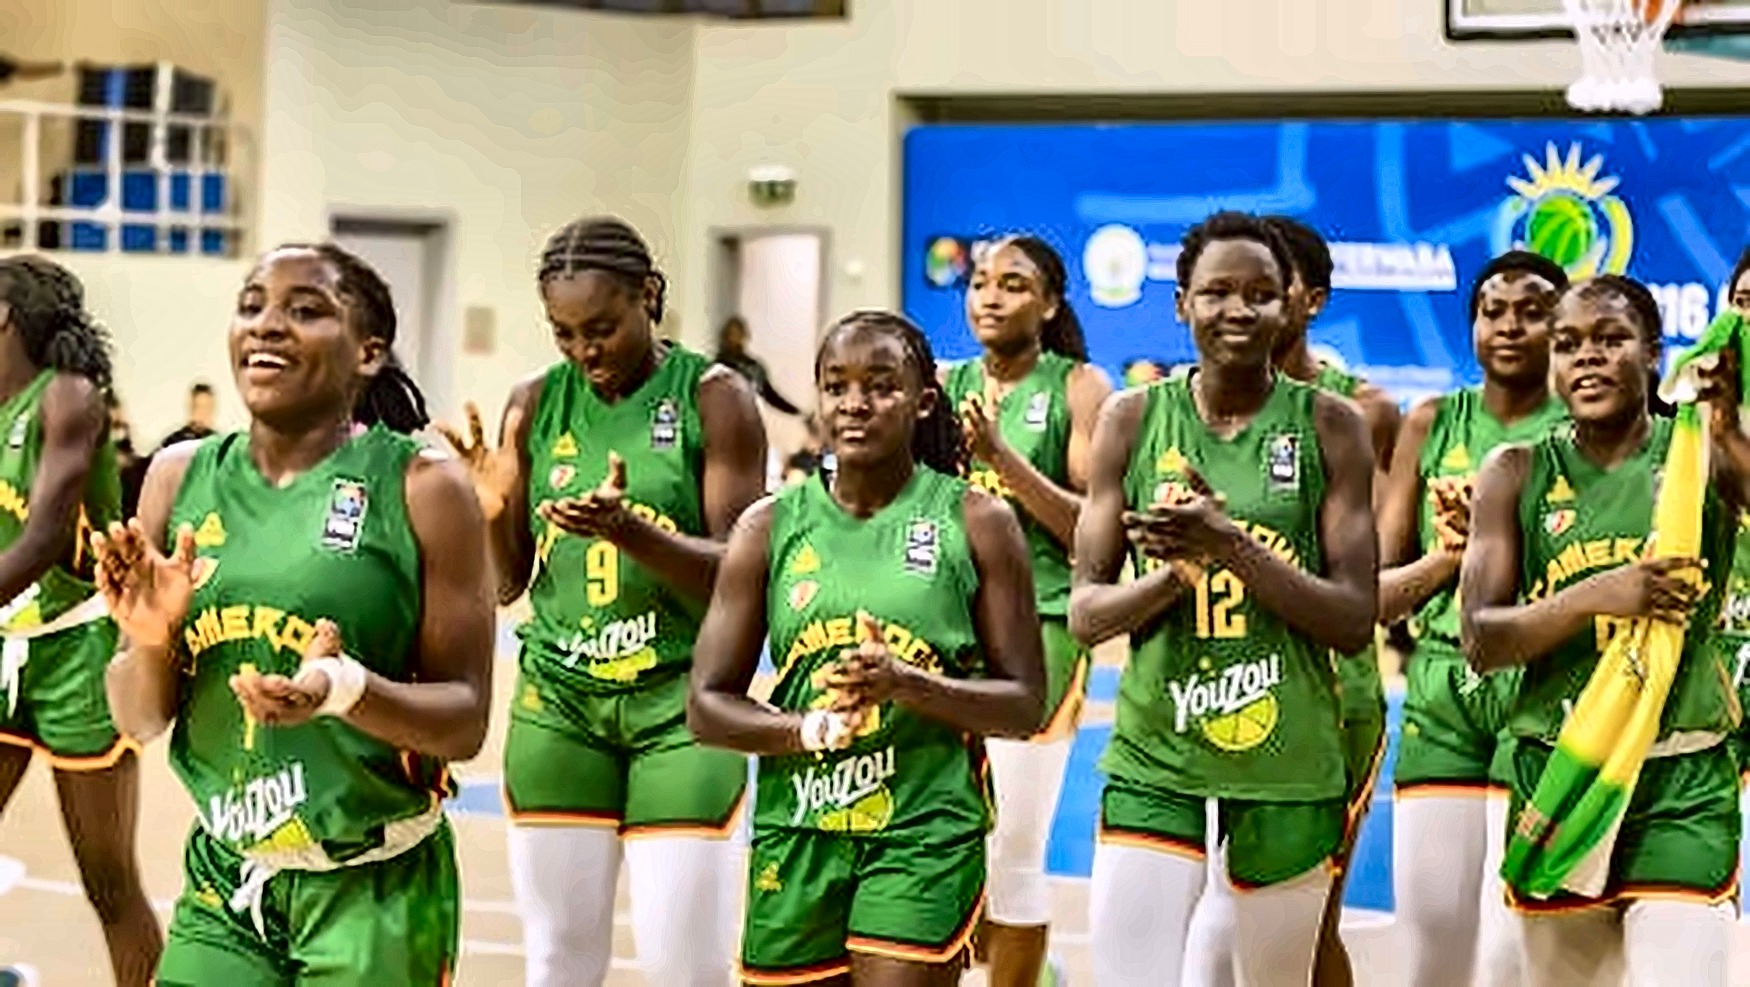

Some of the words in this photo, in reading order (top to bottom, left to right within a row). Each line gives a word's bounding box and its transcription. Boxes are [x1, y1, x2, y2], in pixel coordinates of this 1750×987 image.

[585, 541, 618, 607] 9
[1195, 568, 1247, 639] 12
[1168, 653, 1280, 733] YouZou
[792, 746, 896, 827] YouZou
